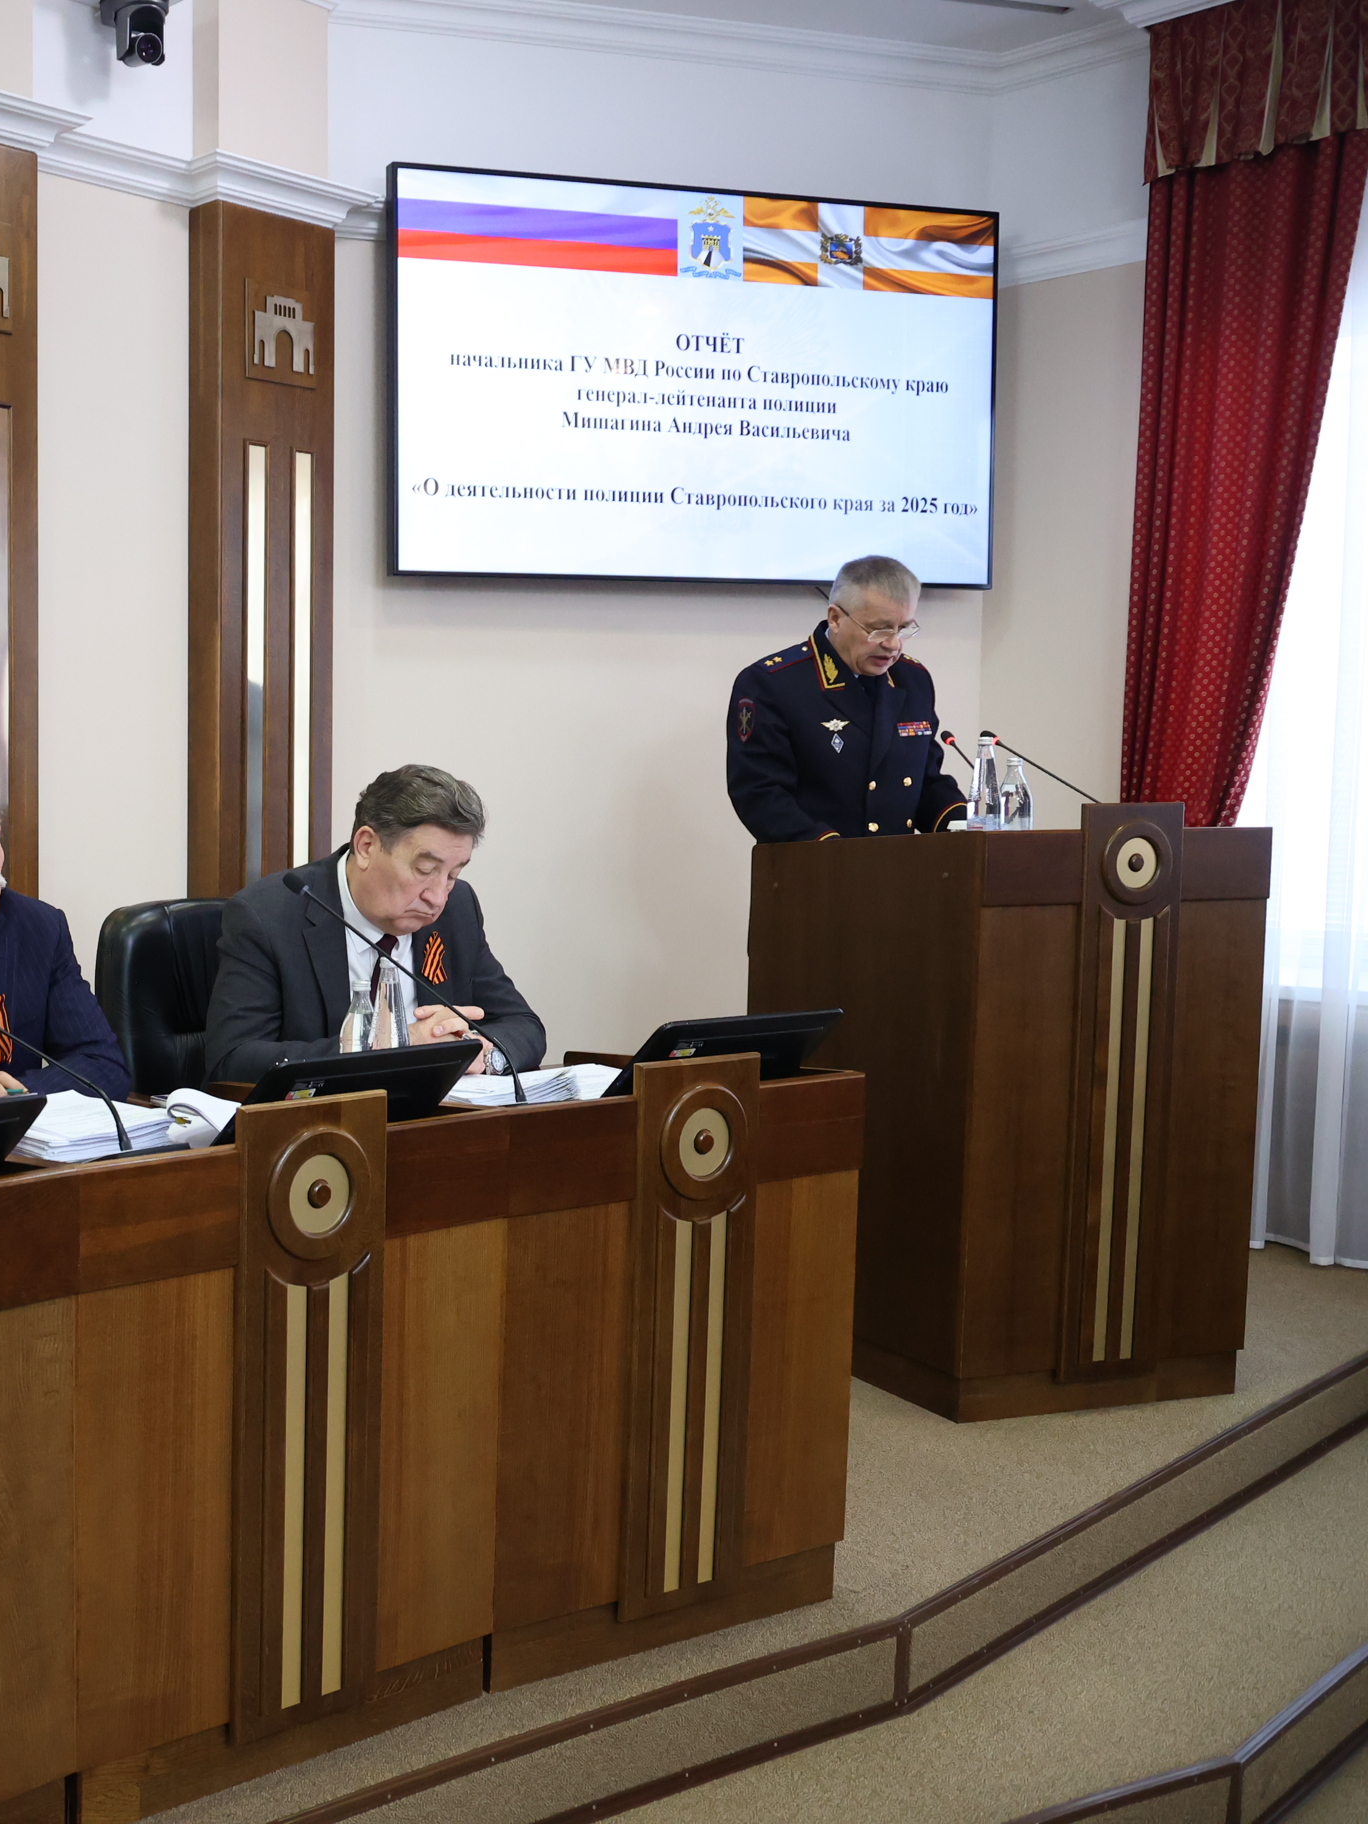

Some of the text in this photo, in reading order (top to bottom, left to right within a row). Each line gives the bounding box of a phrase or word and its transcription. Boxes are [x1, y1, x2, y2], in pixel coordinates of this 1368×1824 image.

[675, 333, 745, 354] ОТЧЁТ
[449, 353, 949, 396] начальника ГУ МВД России по Ставропольскому краю
[577, 388, 838, 415] генерал-лейтенанта полиции
[561, 411, 851, 442] Мишагина Андрея Васильевича
[411, 477, 979, 516] «О деятельности полиции Ставропольского края за 2025 год»
